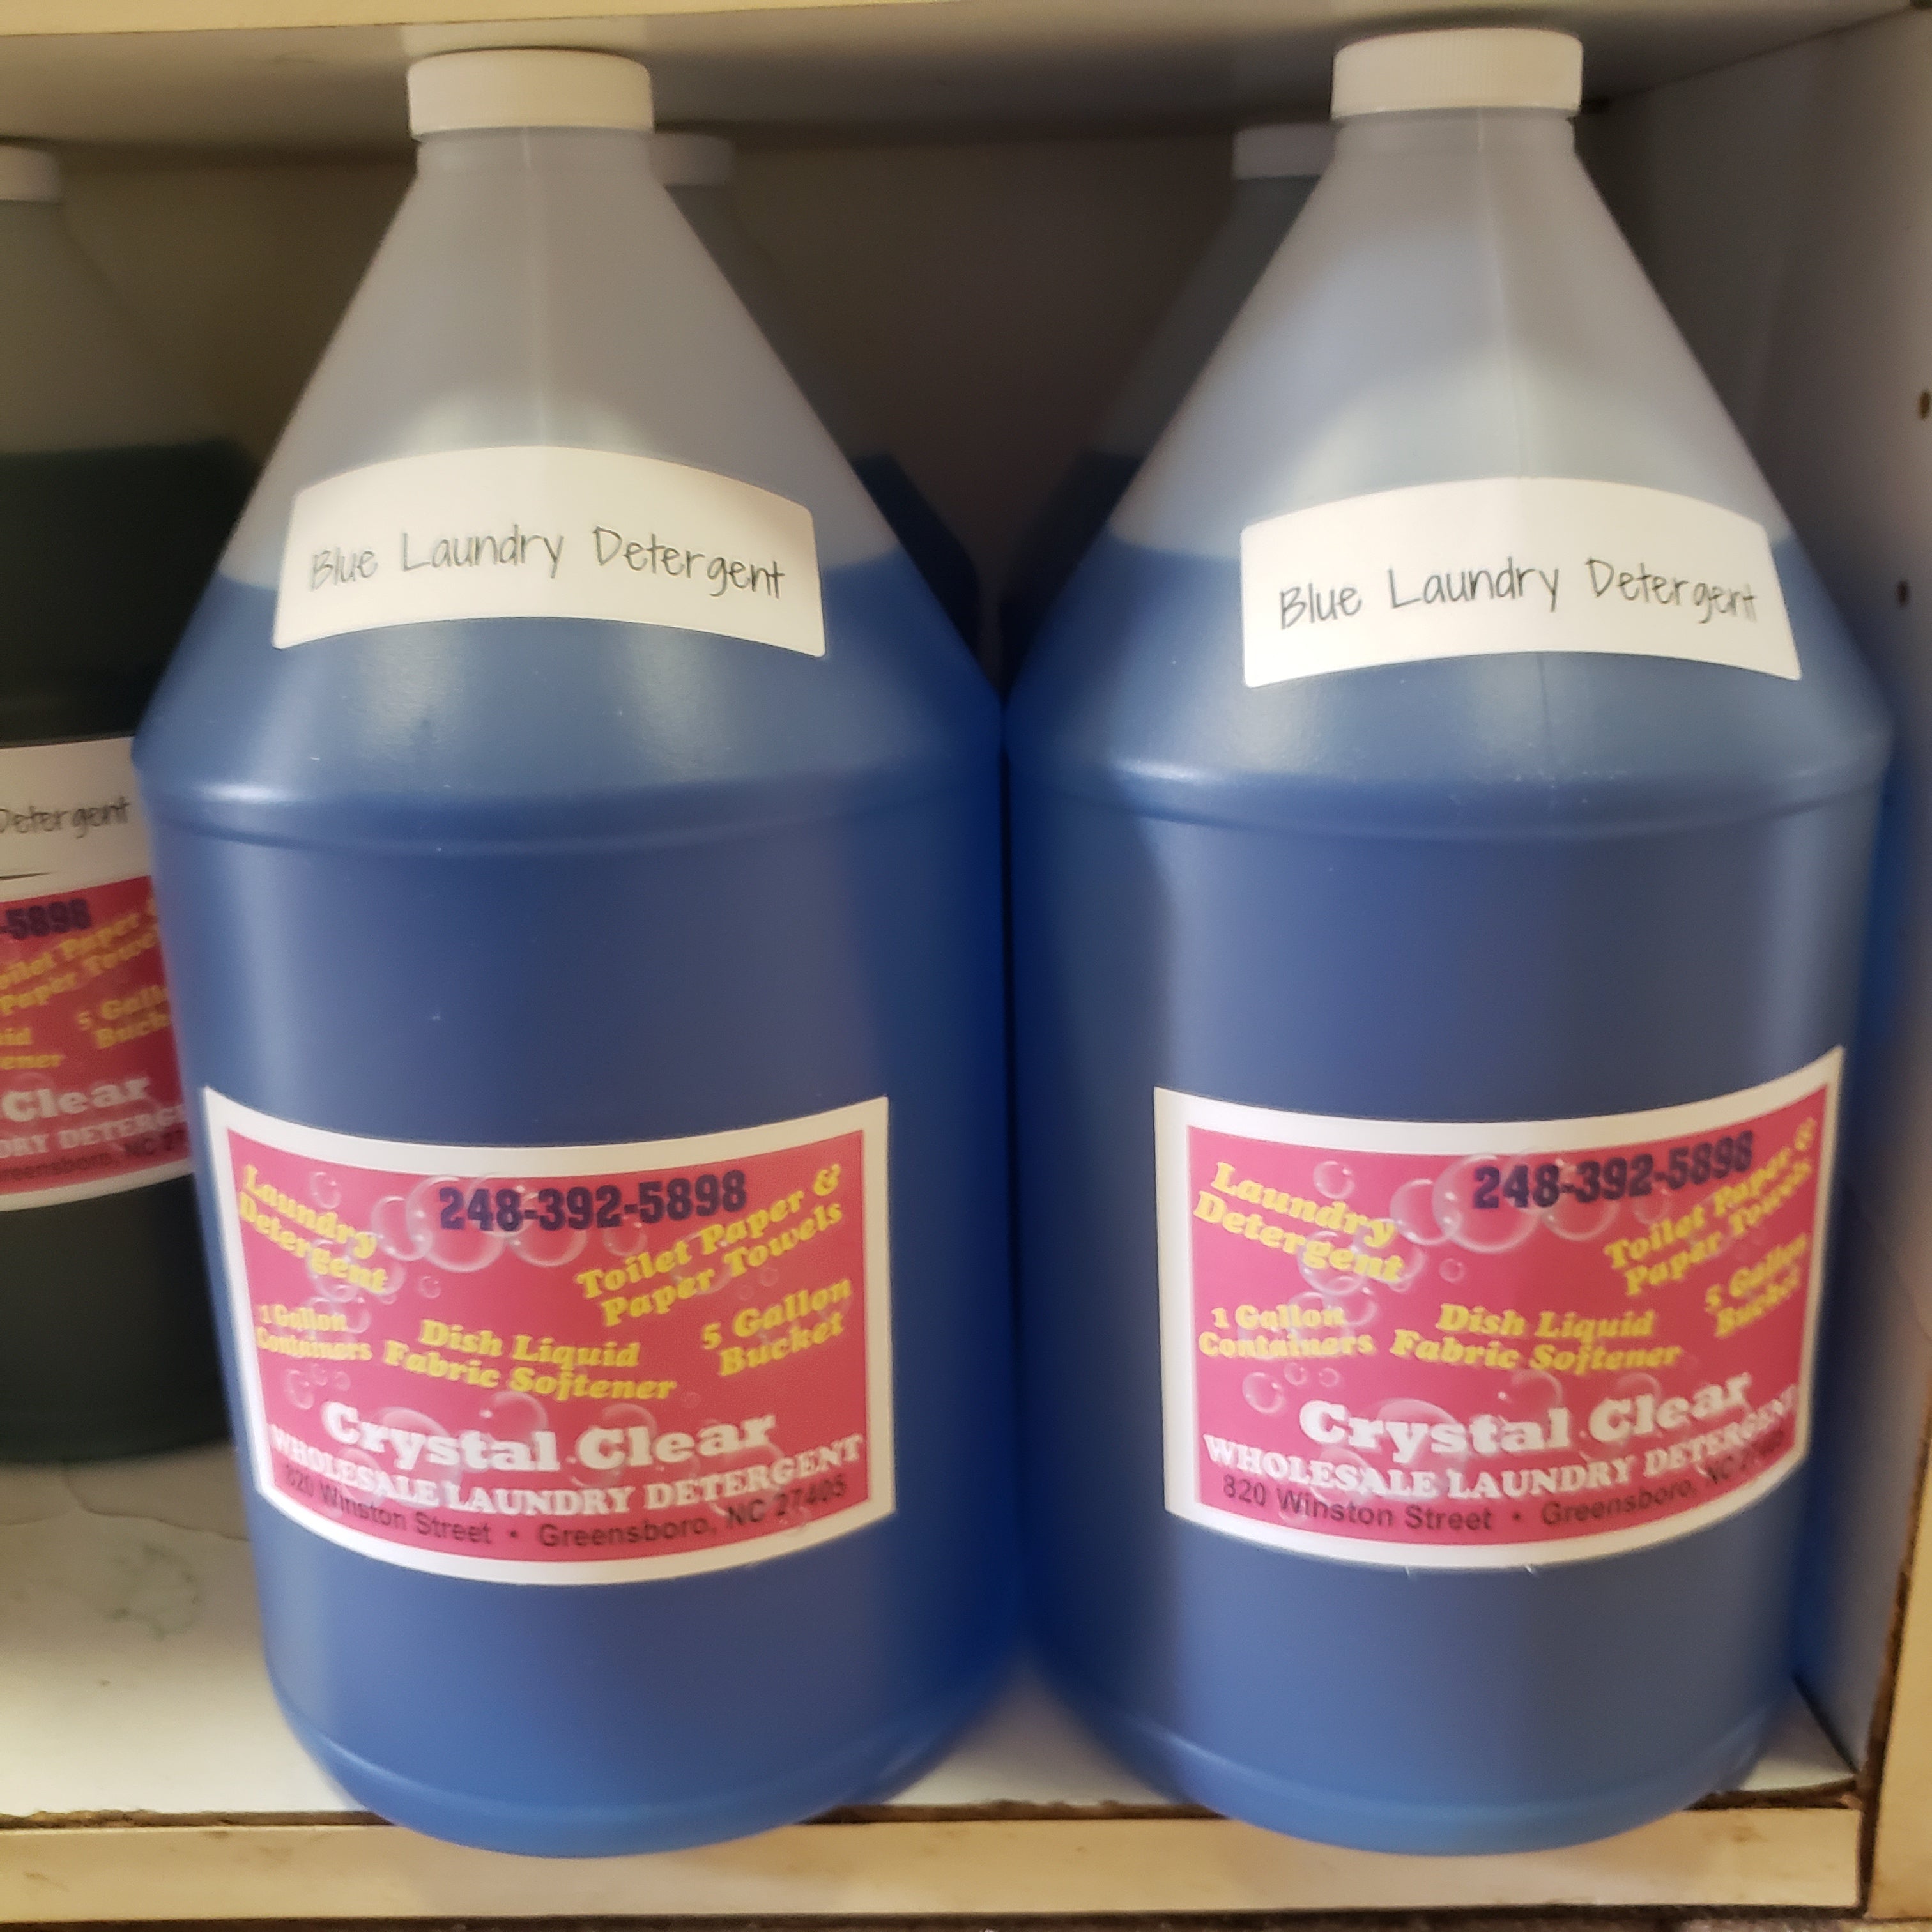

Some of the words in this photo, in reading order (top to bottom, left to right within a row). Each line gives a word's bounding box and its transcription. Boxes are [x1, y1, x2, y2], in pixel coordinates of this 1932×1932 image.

[310, 547, 378, 592] Blue
[401, 524, 564, 579] Laundry
[592, 525, 786, 599] Detergent
[1279, 582, 1363, 629] Blue
[1387, 557, 1560, 613] Laundry
[1586, 557, 1758, 625] Detergent
[1, 1077, 150, 1123] Clear
[438, 1170, 747, 1231] 248-392-5898
[1473, 1130, 1753, 1209] 248-392-5898
[244, 1163, 378, 1259] Laundry
[576, 1240, 692, 1299] Toilet
[698, 1190, 806, 1255] Paper
[812, 1163, 841, 1197] &
[1192, 1190, 1404, 1282] Detergent
[1210, 1161, 1397, 1248] Laundry
[1602, 1204, 1705, 1271] Toilet
[239, 1191, 388, 1293] Detergent
[600, 1269, 716, 1327] Paper
[724, 1203, 843, 1277] Towels
[1625, 1230, 1722, 1296] Paper
[273, 1303, 348, 1332] Gallon
[420, 1318, 503, 1358] Dish
[512, 1335, 640, 1372] Liquid
[703, 1322, 723, 1350] 5
[732, 1278, 852, 1338] Gallon
[717, 1312, 844, 1377] Bucket
[1198, 1331, 1374, 1360] Containers
[1211, 1307, 1230, 1329] 1
[1234, 1304, 1346, 1330] Gallon
[1435, 1303, 1526, 1337] Dish
[1535, 1310, 1656, 1343] Liquid
[384, 1338, 501, 1388] Fabric
[512, 1366, 678, 1402] Softener
[1389, 1328, 1520, 1369] Fabric
[1530, 1344, 1683, 1376] Softener
[321, 1400, 561, 1473] Crystal
[576, 1413, 777, 1471] Clear
[1299, 1399, 1571, 1464] Crystal
[1588, 1371, 1752, 1443] Clear
[268, 1423, 440, 1507] WHOLESALE
[446, 1482, 636, 1516] LAUNDRY
[644, 1432, 865, 1511] DETERGENT
[1202, 1434, 1439, 1499] WHOLESALE
[1445, 1456, 1637, 1511] LAUNDRY
[1223, 1473, 1267, 1507] 820
[1277, 1487, 1393, 1527] Winston
[1405, 1504, 1492, 1532] Street
[319, 1482, 408, 1531] Winston
[414, 1509, 493, 1545] Street
[725, 1498, 766, 1529] NC
